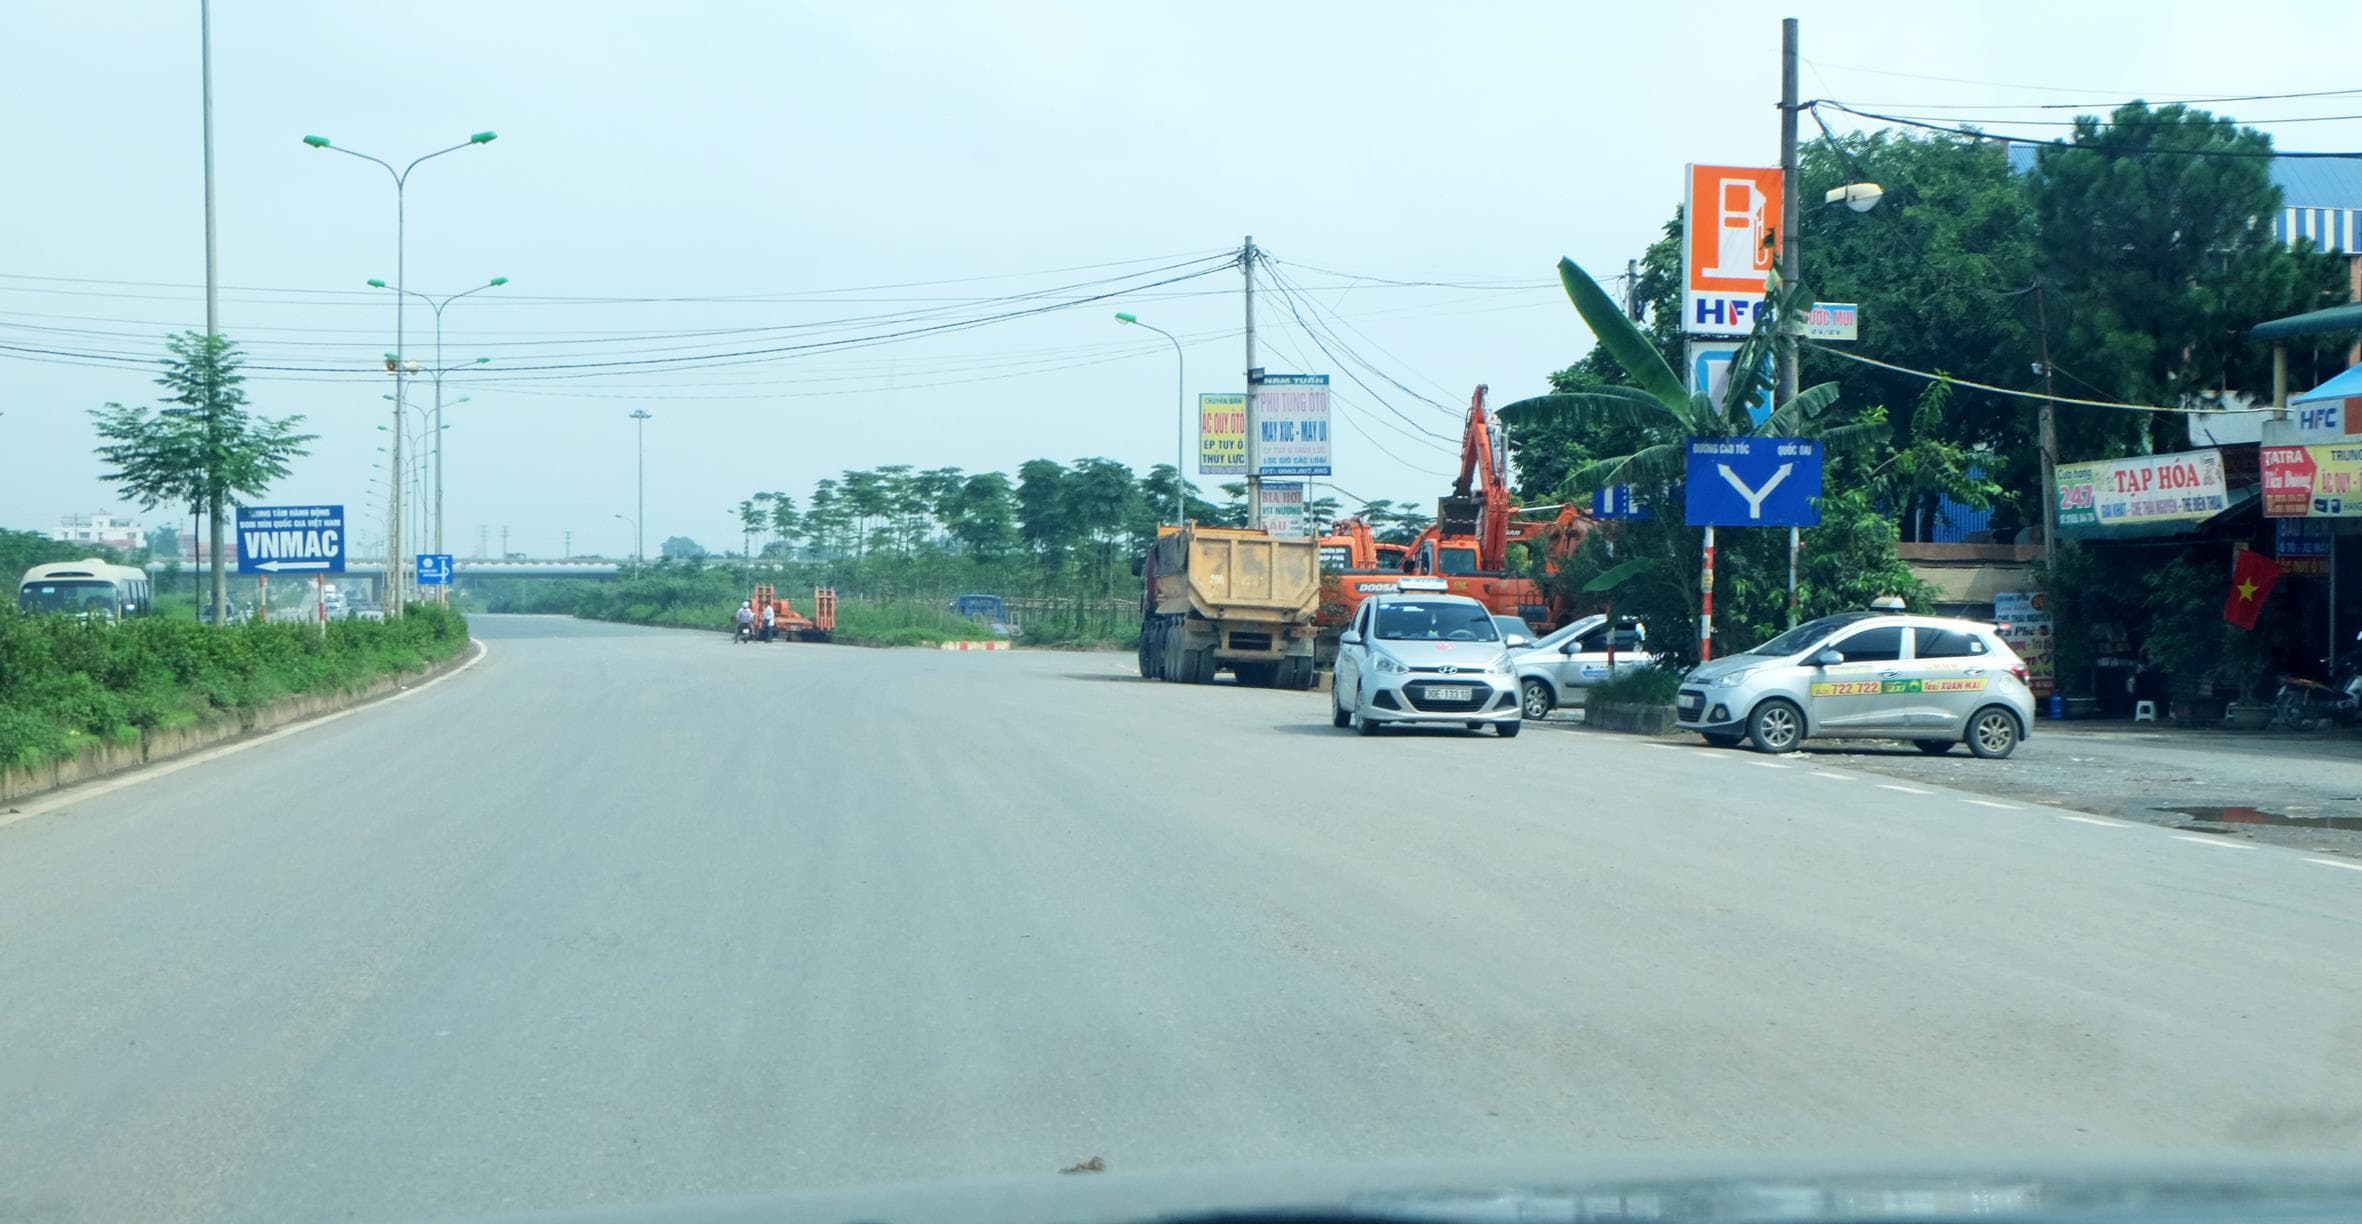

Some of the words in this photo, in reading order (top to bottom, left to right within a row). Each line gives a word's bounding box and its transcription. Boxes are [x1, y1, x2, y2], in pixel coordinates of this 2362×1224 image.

[1262, 416, 1277, 441] MÁY
[1301, 416, 1317, 441] MÁY
[2301, 408, 2336, 429] HFC
[2264, 450, 2304, 467] TATRA
[2114, 468, 2152, 496] TẠP
[2157, 457, 2200, 489] HÓA
[2060, 485, 2093, 509] 247
[244, 530, 339, 559] VNMAC
[1832, 683, 1852, 694] 722
[1857, 681, 1878, 693] 722
